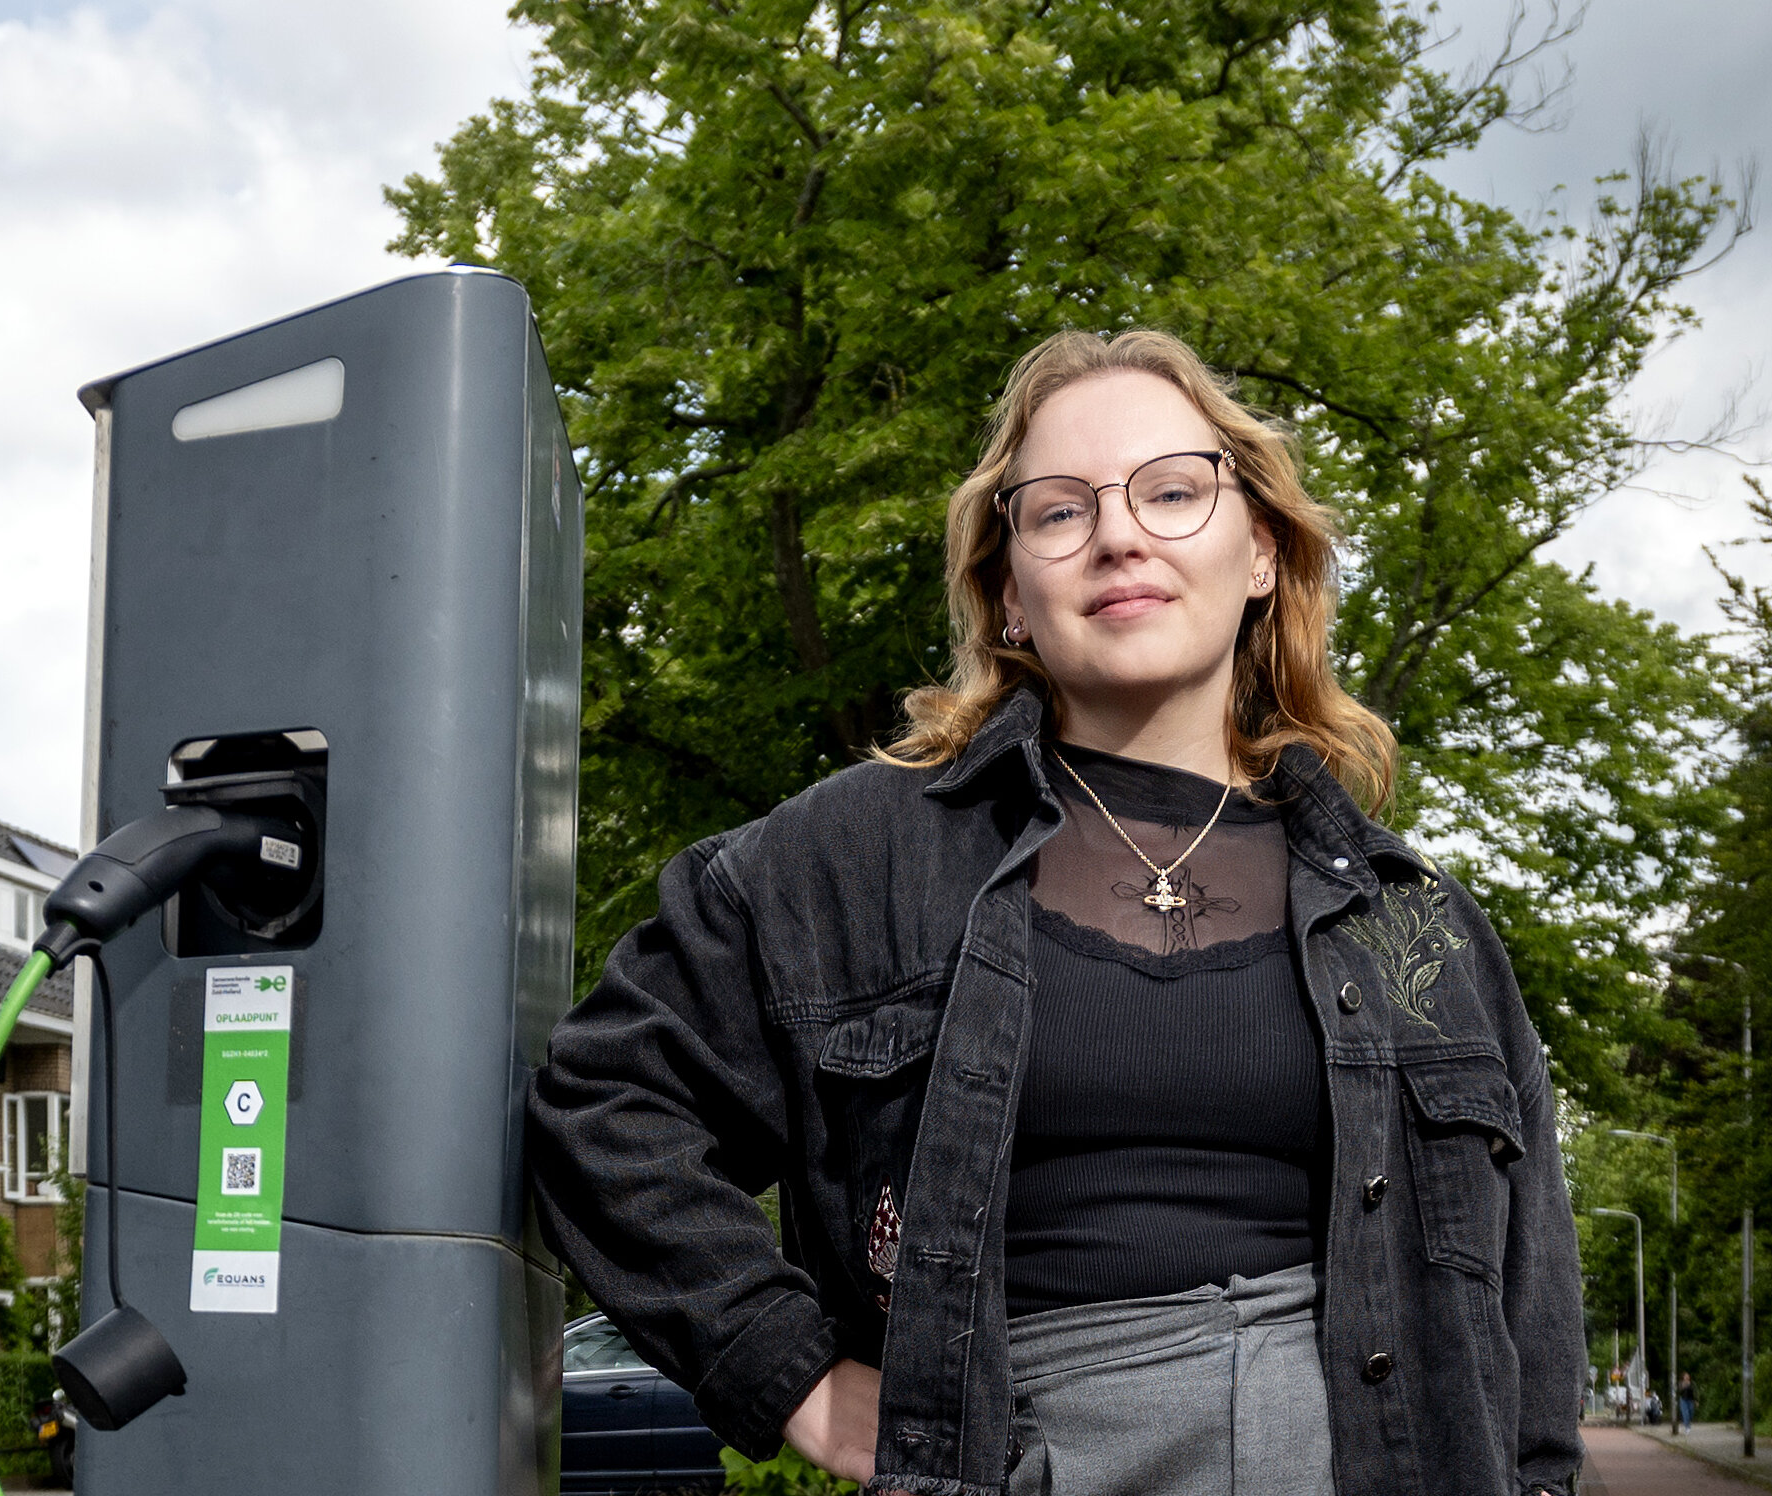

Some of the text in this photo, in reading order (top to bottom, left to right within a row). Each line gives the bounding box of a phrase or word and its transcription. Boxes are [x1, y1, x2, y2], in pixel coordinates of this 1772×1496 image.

[216, 1012, 279, 1023] OPLAADPUNT
[237, 1092, 251, 1113] C
[217, 1274, 265, 1284] EQUANS
